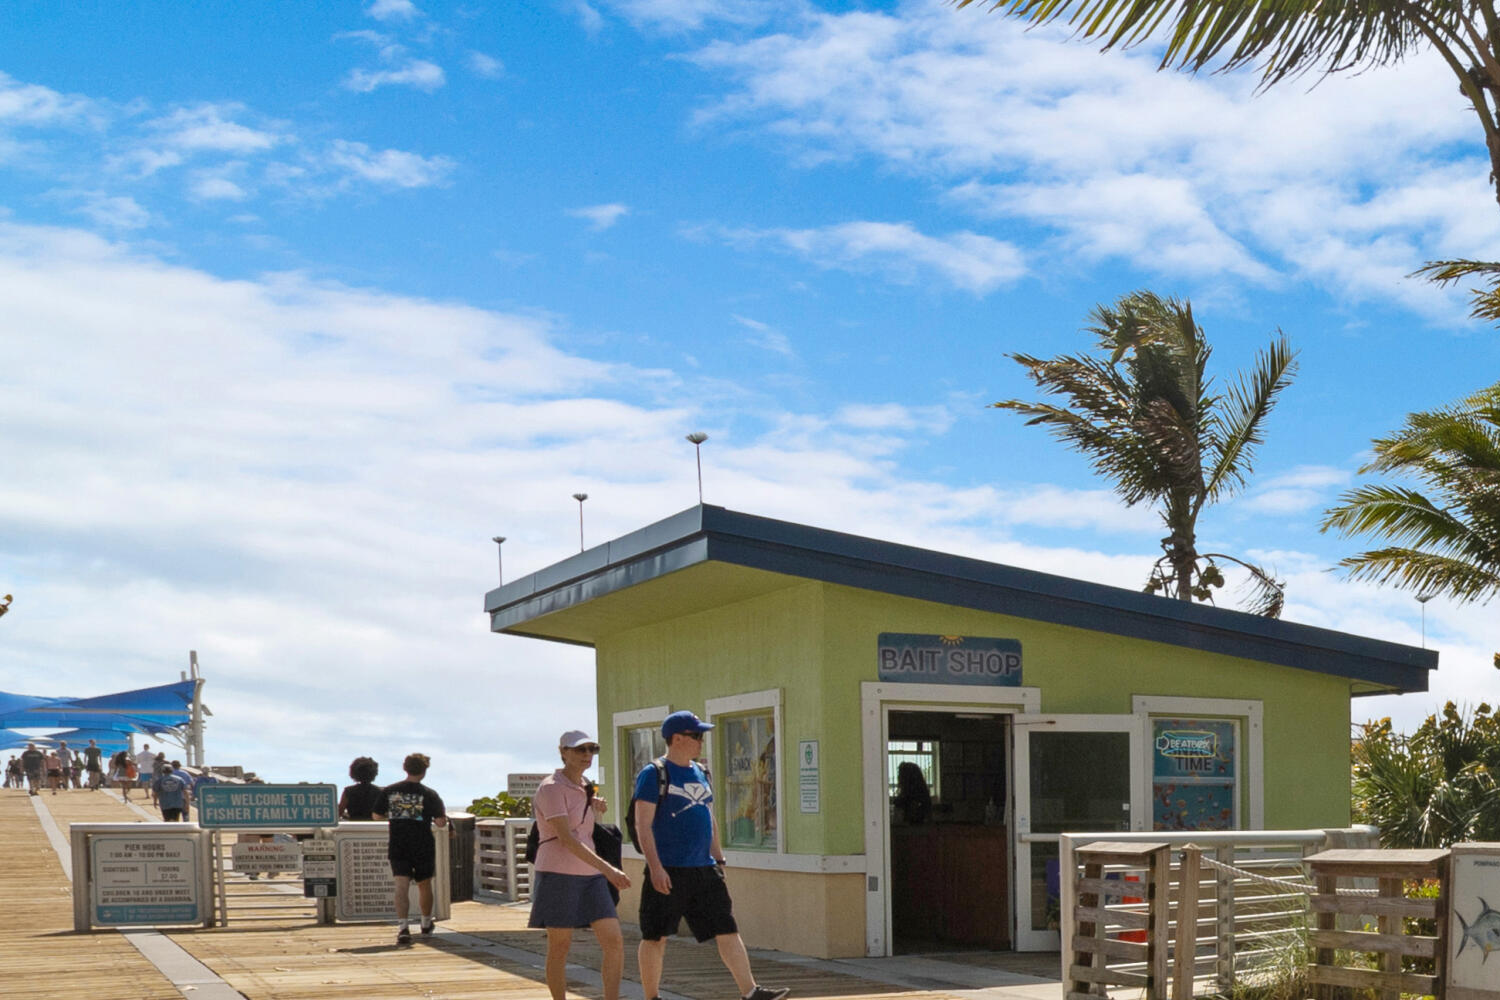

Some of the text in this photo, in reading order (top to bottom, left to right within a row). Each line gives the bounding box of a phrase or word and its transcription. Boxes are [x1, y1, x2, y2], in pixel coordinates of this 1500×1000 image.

[881, 648, 1020, 675] BAIT SHOP
[1177, 757, 1213, 771] TIME
[230, 793, 287, 806] WELCOME
[289, 793, 305, 805] TO
[308, 793, 330, 805] THE
[206, 807, 330, 820] FISHER FAMILY PIER
